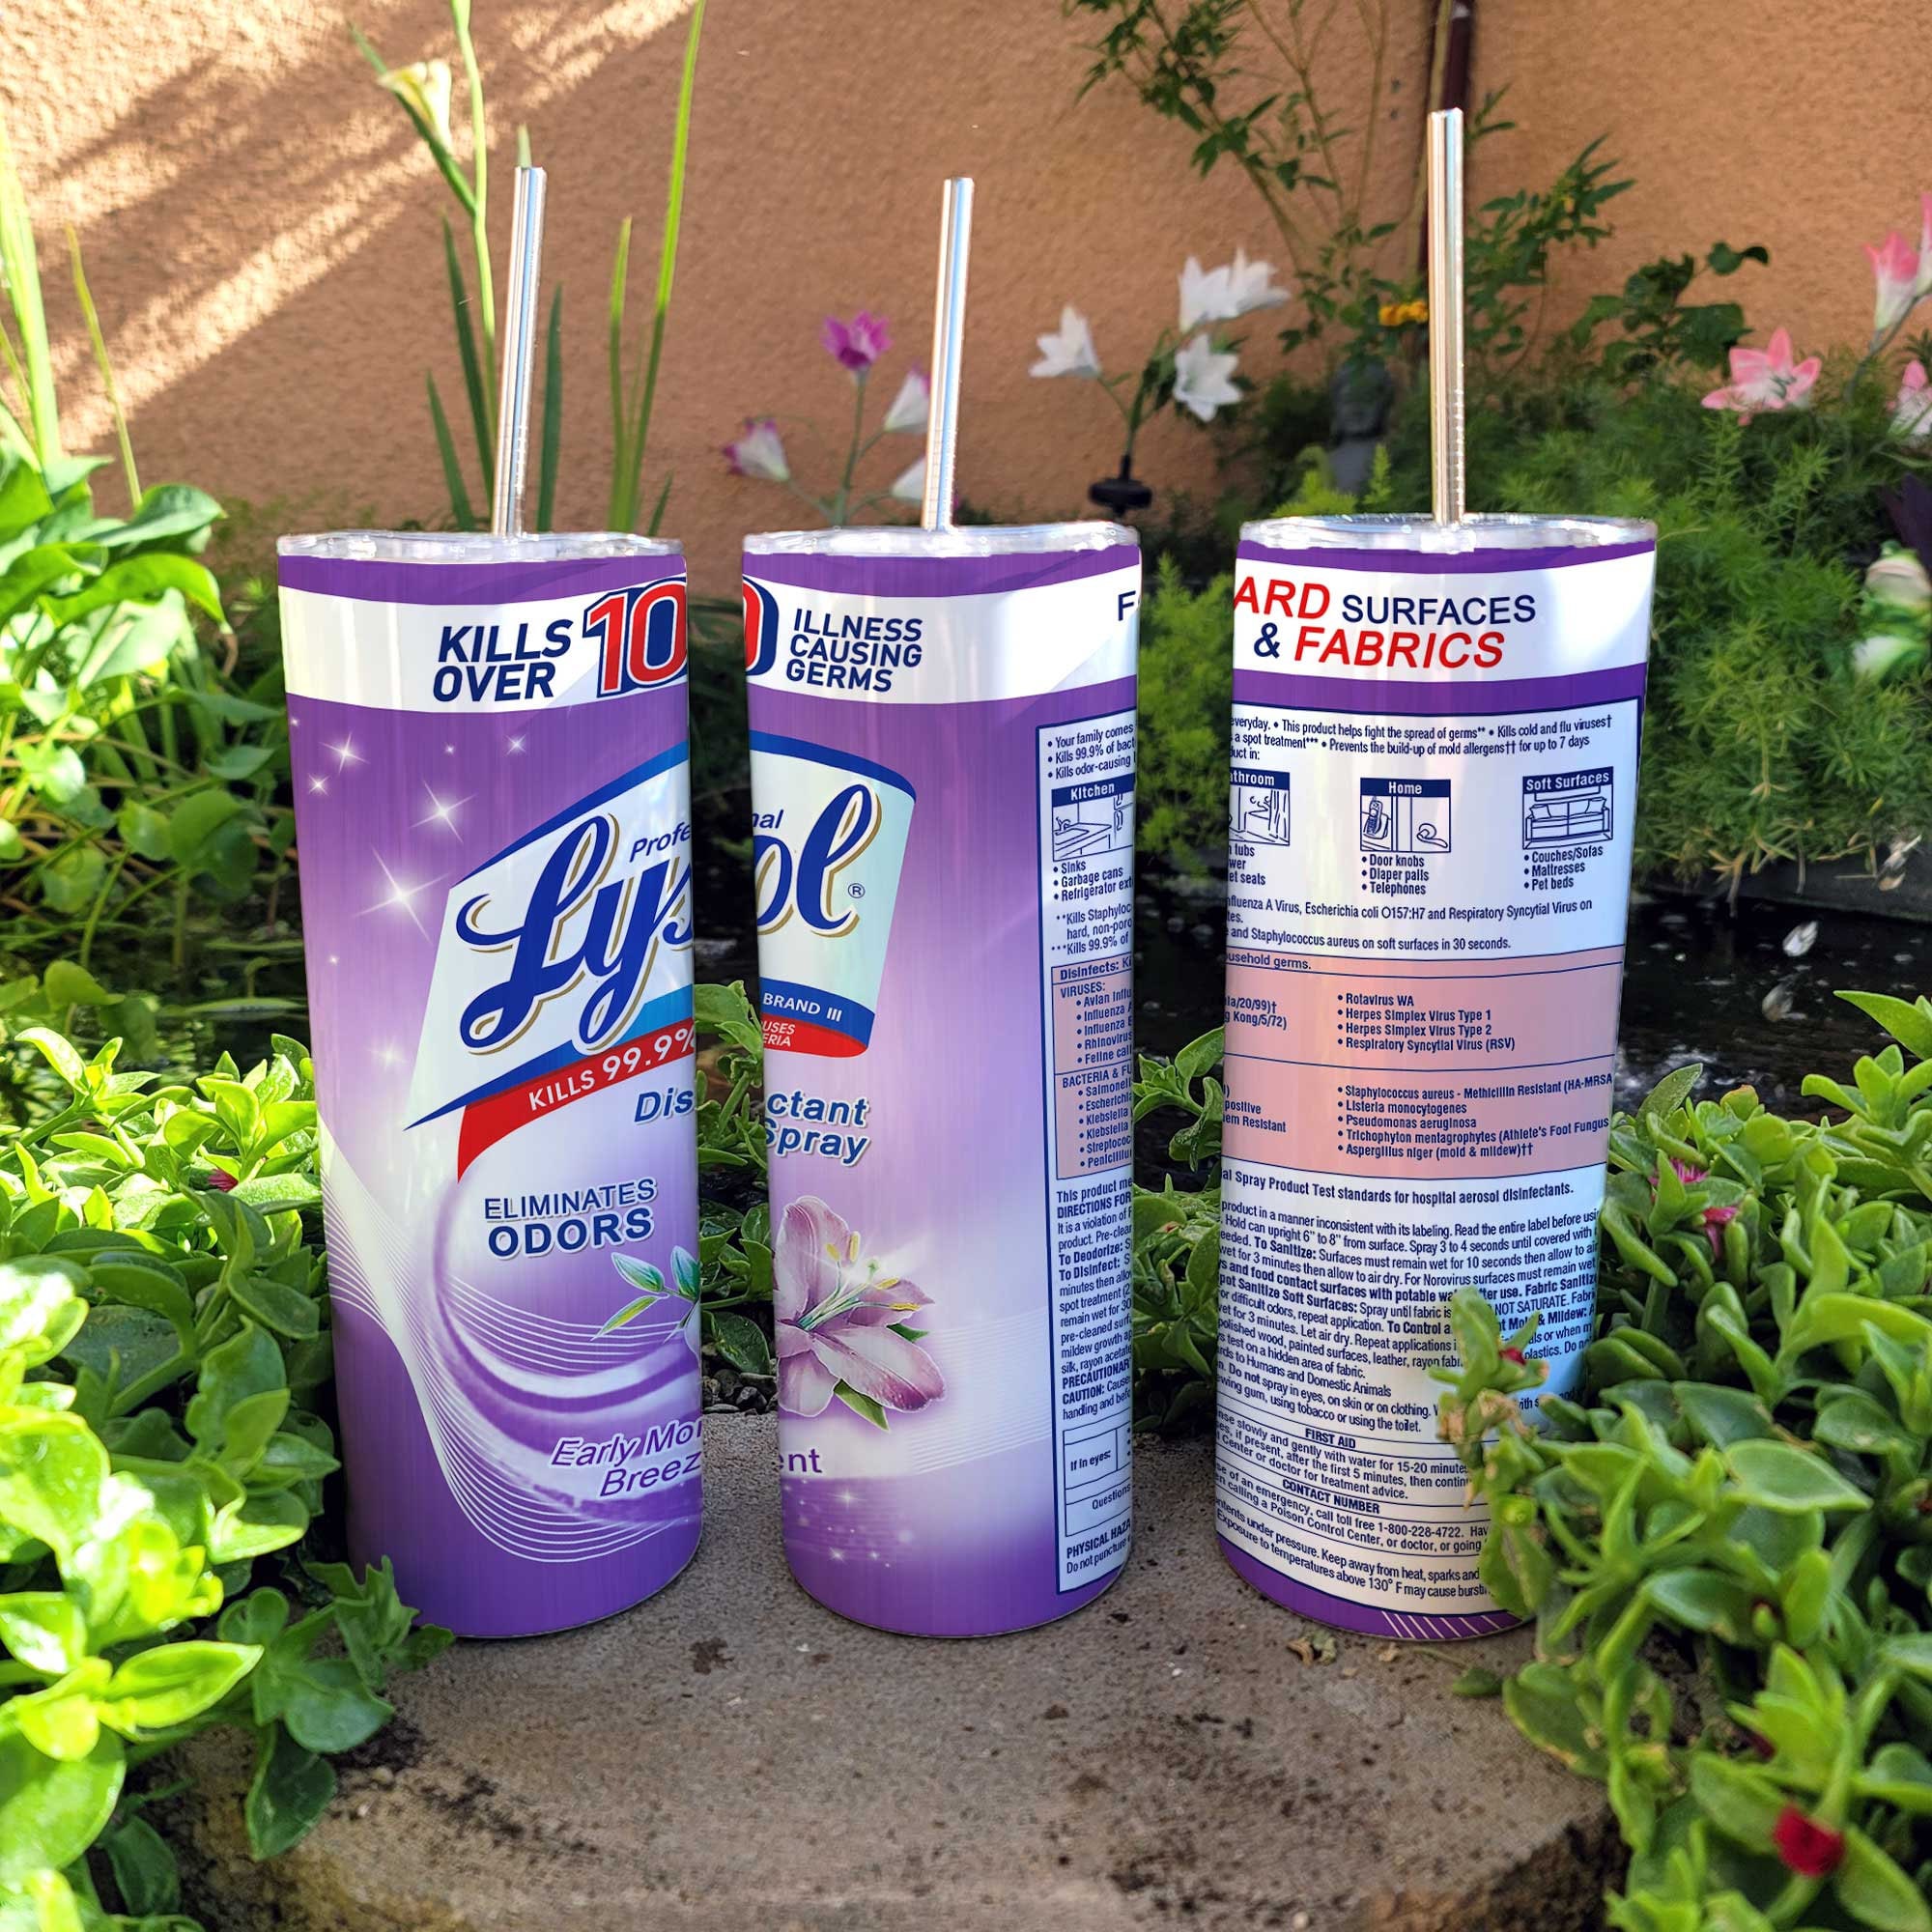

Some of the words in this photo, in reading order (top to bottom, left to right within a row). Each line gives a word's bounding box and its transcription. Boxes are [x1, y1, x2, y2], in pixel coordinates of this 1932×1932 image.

[1234, 576, 1330, 619] ARD
[1342, 595, 1536, 625] SURFACES
[793, 609, 923, 641] ILLNESS
[438, 619, 573, 663] KILLS
[1254, 622, 1280, 659] &
[1294, 626, 1505, 668] FABRICS
[790, 635, 923, 668] CAUSING
[433, 663, 556, 701] OVER
[785, 660, 893, 692] GERMS
[1055, 736, 1074, 749] Your
[1077, 729, 1103, 745] family
[1106, 724, 1133, 738] comes
[1282, 720, 1299, 732] This
[1303, 723, 1336, 736] product
[1338, 724, 1362, 737] helps
[1365, 725, 1384, 740] fight
[1388, 726, 1402, 738] the
[1404, 726, 1435, 742] spread
[1437, 727, 1446, 739] of
[1497, 725, 1517, 737] Kills
[1519, 724, 1537, 736] cold
[1541, 723, 1556, 735] and
[1560, 721, 1571, 732] flu
[1056, 751, 1073, 764] Kills
[1076, 745, 1103, 759] 99.9%
[1106, 741, 1115, 754] of
[1056, 767, 1073, 779] Kills
[1076, 755, 1130, 775] odor-causing
[1388, 781, 1422, 795] Home
[1526, 779, 1550, 791] Soft
[1555, 772, 1608, 788] Surfaces
[1071, 783, 1114, 801] Kitchen
[1370, 854, 1393, 867] Door
[1396, 855, 1425, 867] knobs
[1532, 845, 1603, 864] Couches/Sofas
[1062, 860, 1086, 874] Sinks
[1370, 867, 1402, 883] Diaper
[1405, 869, 1429, 883] pails
[1532, 862, 1585, 877] Mattresses
[1062, 874, 1099, 888] Garbage
[1102, 867, 1122, 880] cans
[1532, 878, 1548, 891] Pet
[1551, 876, 1574, 890] beds
[1062, 882, 1116, 902] Refrigerator
[1370, 881, 1426, 896] Telephones
[1265, 898, 1272, 911] A
[1274, 899, 1301, 916] Virus,
[1306, 902, 1358, 918] Escherichia
[1362, 906, 1378, 918] coli
[1428, 908, 1445, 920] and
[1449, 905, 1504, 923] Respiratory
[1507, 902, 1549, 921] Syncytial
[1552, 900, 1577, 914] Virus
[1579, 899, 1592, 910] on
[1231, 927, 1248, 939] and
[1251, 927, 1324, 946] Staphylococcus
[1327, 936, 1359, 949] aureus
[1362, 939, 1374, 950] on
[1378, 937, 1396, 951] soft
[1398, 937, 1438, 951] surfaces
[1441, 938, 1450, 950] in
[1453, 938, 1465, 951] 30
[1468, 937, 1511, 951] seconds.
[1061, 961, 1119, 980] Disinfects:
[1274, 957, 1311, 970] germs.
[1061, 981, 1105, 997] VIRUSES:
[762, 993, 820, 1014] BRAND
[827, 1008, 842, 1022] III
[1084, 994, 1109, 1008] Avian
[1347, 993, 1394, 1006] Rotavirus
[1397, 995, 1414, 1007] WA
[1084, 1005, 1124, 1022] Influenza
[1347, 1008, 1381, 1022] Herpes
[1385, 1009, 1426, 1023] Simplex
[1430, 1010, 1455, 1021] Virus
[1459, 1009, 1482, 1023] Type
[1485, 1009, 1491, 1020] 1
[1085, 1019, 1124, 1036] Influenza
[1347, 1022, 1381, 1037] Herpes
[1385, 1024, 1426, 1037] Simplex
[1430, 1025, 1455, 1036] Virus
[1459, 1024, 1482, 1037] Type
[1486, 1024, 1492, 1035] 2
[1085, 1031, 1132, 1050] Rhinovirus
[1347, 1037, 1405, 1053] Respiratory
[1407, 1039, 1453, 1053] Syncytial
[1457, 1039, 1482, 1050] Virus
[1486, 1037, 1515, 1053] (RSV)
[1085, 1050, 1114, 1064] Feline
[528, 1069, 595, 1111] KILLS
[603, 1027, 696, 1081] 99.9%
[1063, 1071, 1109, 1088] BACTERIA
[1113, 1068, 1118, 1078] &
[1346, 1085, 1419, 1099] Staphylococcus
[1422, 1090, 1454, 1099] aureus
[1518, 1082, 1561, 1095] Resistant
[1087, 1107, 1128, 1125] Klebsiella
[1347, 1099, 1384, 1113] Listeria
[1388, 1103, 1466, 1117] monocytogenes
[1087, 1122, 1128, 1140] Klebsiella
[1347, 1115, 1416, 1128] Pseudomonas
[1420, 1118, 1476, 1131] aeruginosa
[1347, 1129, 1411, 1144] Trichophyton
[1499, 1126, 1547, 1144] (Athlete's
[1549, 1123, 1571, 1136] Foot
[1575, 1118, 1608, 1132] Fungus
[1347, 1144, 1404, 1158] Aspergillus
[1406, 1148, 1433, 1160] niger
[1435, 1147, 1465, 1161] (mold
[1469, 1147, 1476, 1157] &
[485, 1179, 656, 1219] ELIMINATES
[1057, 1190, 1078, 1203] This
[1082, 1179, 1116, 1202] product
[1236, 1171, 1265, 1190] Spray
[1269, 1177, 1309, 1195] Product
[1313, 1184, 1335, 1198] Test
[1338, 1187, 1391, 1203] standards
[1395, 1191, 1408, 1204] for
[1412, 1191, 1456, 1207] hospital
[1460, 1190, 1498, 1203] aerosol
[1503, 1182, 1574, 1202] disinfectants.
[1057, 1197, 1112, 1218] DIRECTIONS
[1115, 1192, 1131, 1207] FOR
[488, 1208, 651, 1257] ODORS
[1059, 1254, 1070, 1265] To
[1074, 1242, 1122, 1263] Deodorize:
[1059, 1269, 1071, 1281] To
[1074, 1258, 1120, 1278] Disinfect:
[1064, 1384, 1104, 1405] CAUTION:
[1305, 1428, 1335, 1444] FIRST
[1338, 1435, 1356, 1448] AID
[552, 1435, 639, 1466] Early
[1070, 1460, 1076, 1471] If
[1079, 1458, 1087, 1468] in
[1093, 1484, 1130, 1510] Questions
[1283, 1479, 1331, 1503] CONTACT
[1333, 1494, 1380, 1515] NUMBER
[1378, 1522, 1463, 1538] 1-800-228-4722.
[1066, 1534, 1109, 1559] PHYSICAL
[1377, 1563, 1399, 1577] from
[1402, 1567, 1426, 1581] heat,
[1428, 1569, 1461, 1585] sparks
[1463, 1569, 1479, 1579] and
